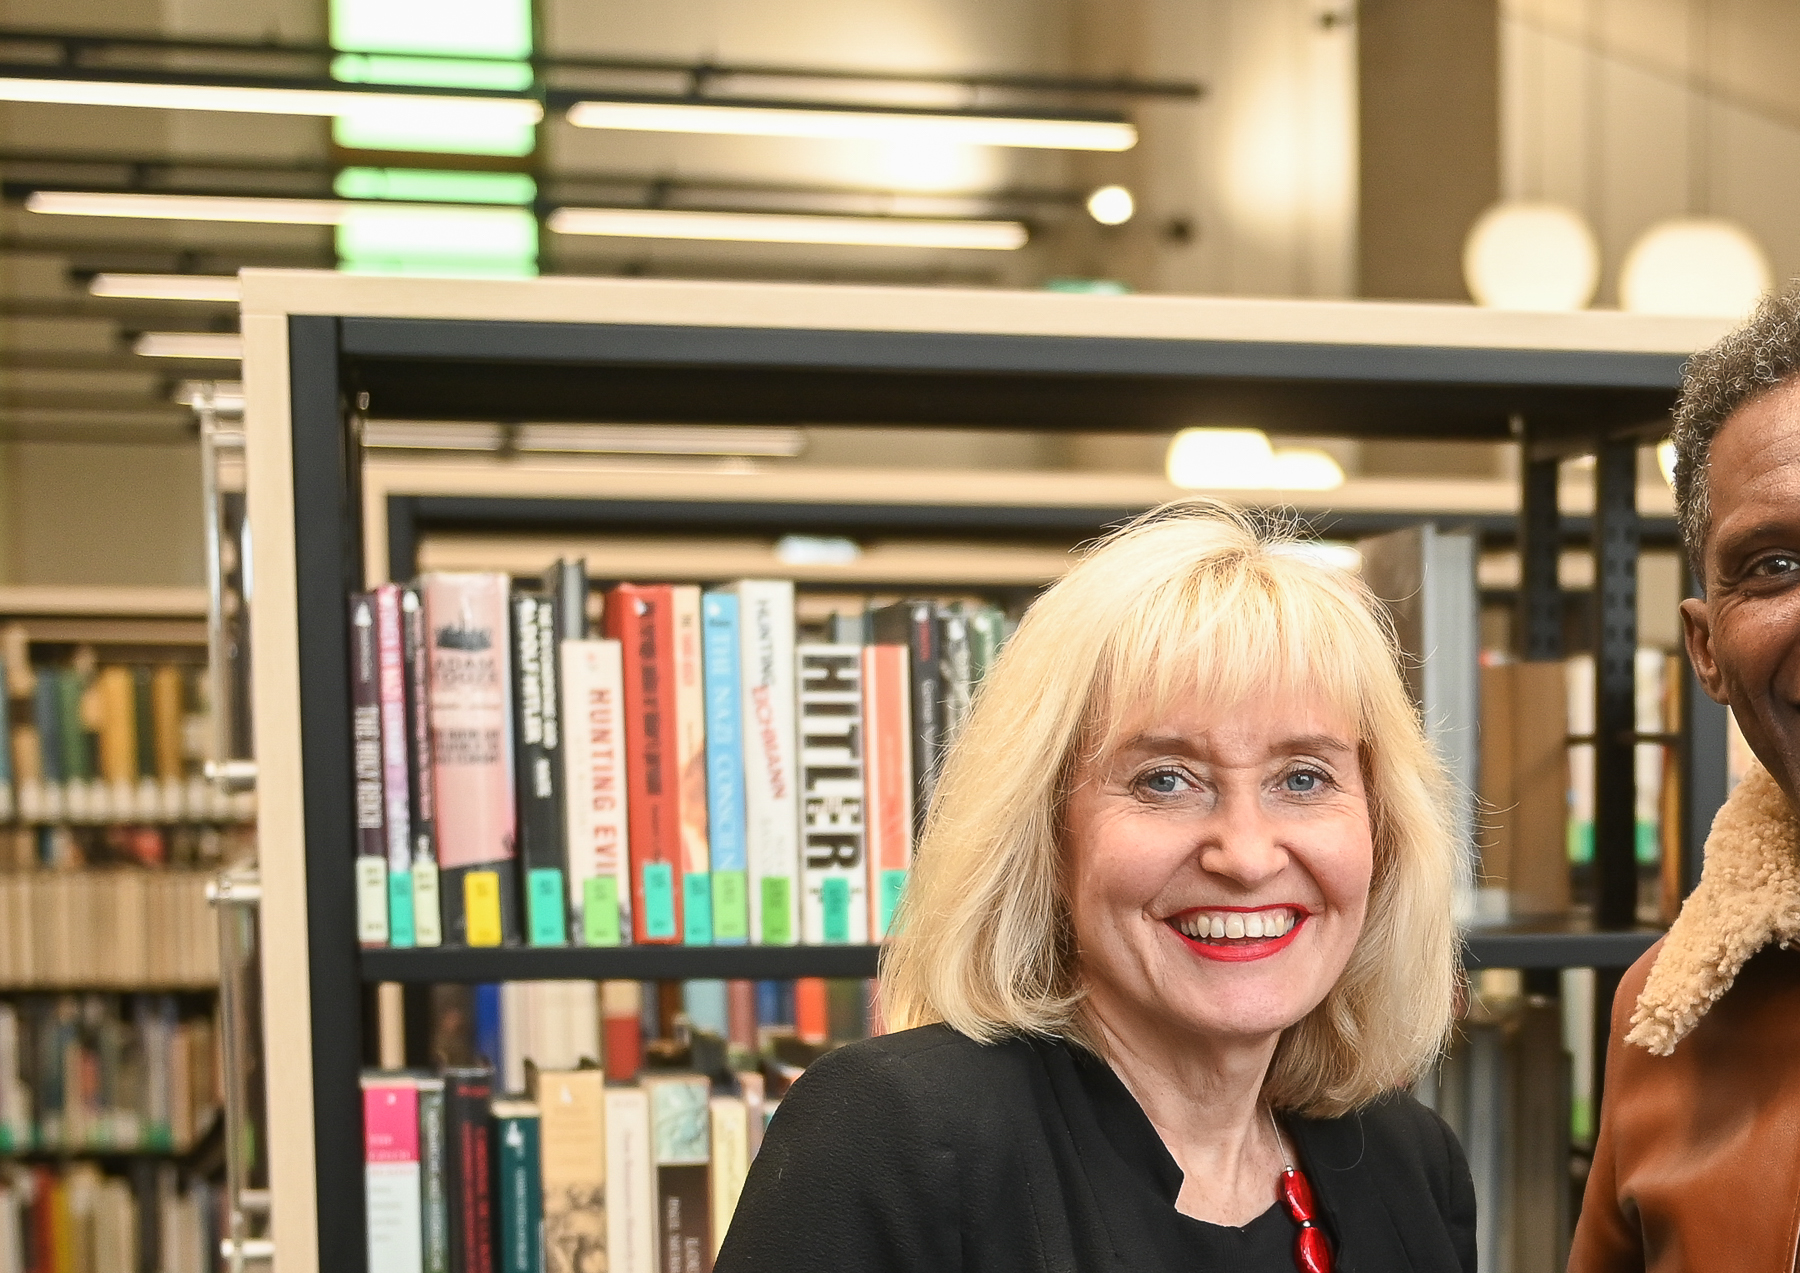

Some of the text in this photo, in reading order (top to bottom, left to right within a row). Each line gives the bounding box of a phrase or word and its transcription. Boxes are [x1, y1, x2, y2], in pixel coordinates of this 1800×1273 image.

[589, 688, 616, 812] HUNTING
[713, 685, 733, 744] NAZI
[751, 598, 787, 799] HUNTING EICHMANN
[804, 656, 861, 871] HITLER
